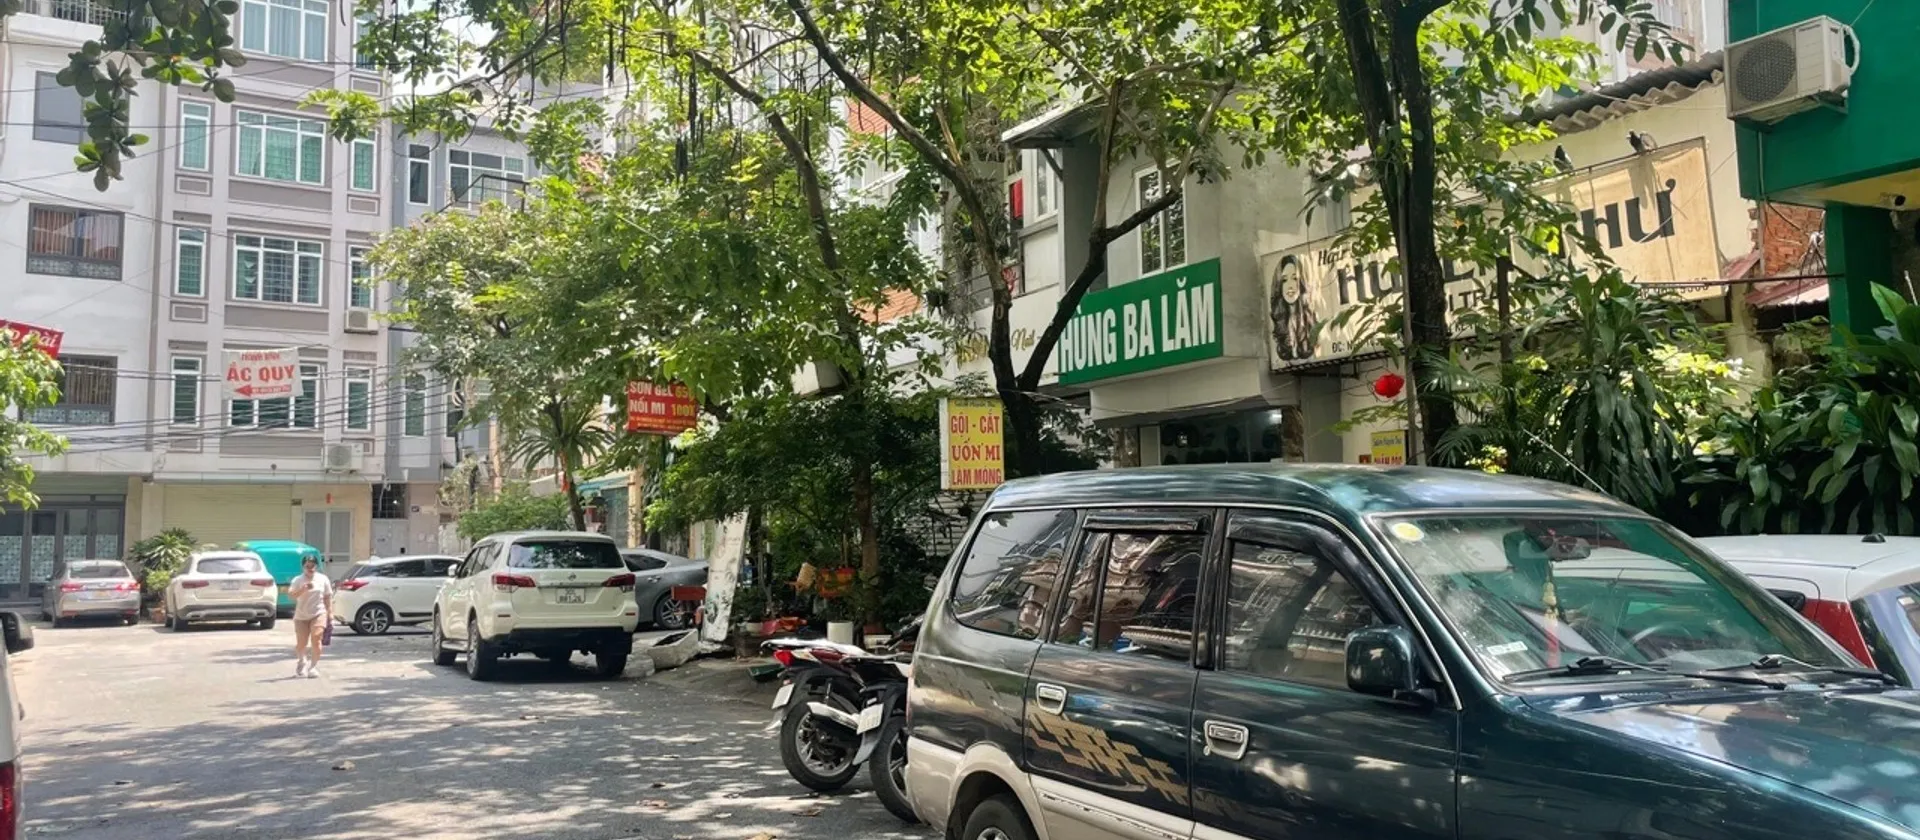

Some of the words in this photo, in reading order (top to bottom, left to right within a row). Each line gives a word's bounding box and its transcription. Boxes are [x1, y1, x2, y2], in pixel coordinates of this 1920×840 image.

[1061, 302, 1118, 374] HÙNG
[1123, 299, 1156, 361] BA
[1161, 276, 1216, 353] LĂM
[258, 364, 296, 383] QUY
[650, 401, 666, 416] MI
[950, 411, 969, 438] GỘI
[979, 407, 1001, 434] CẮT
[984, 444, 1001, 461] MI
[951, 464, 972, 486] LÀM
[974, 464, 1002, 486] MÓNG
